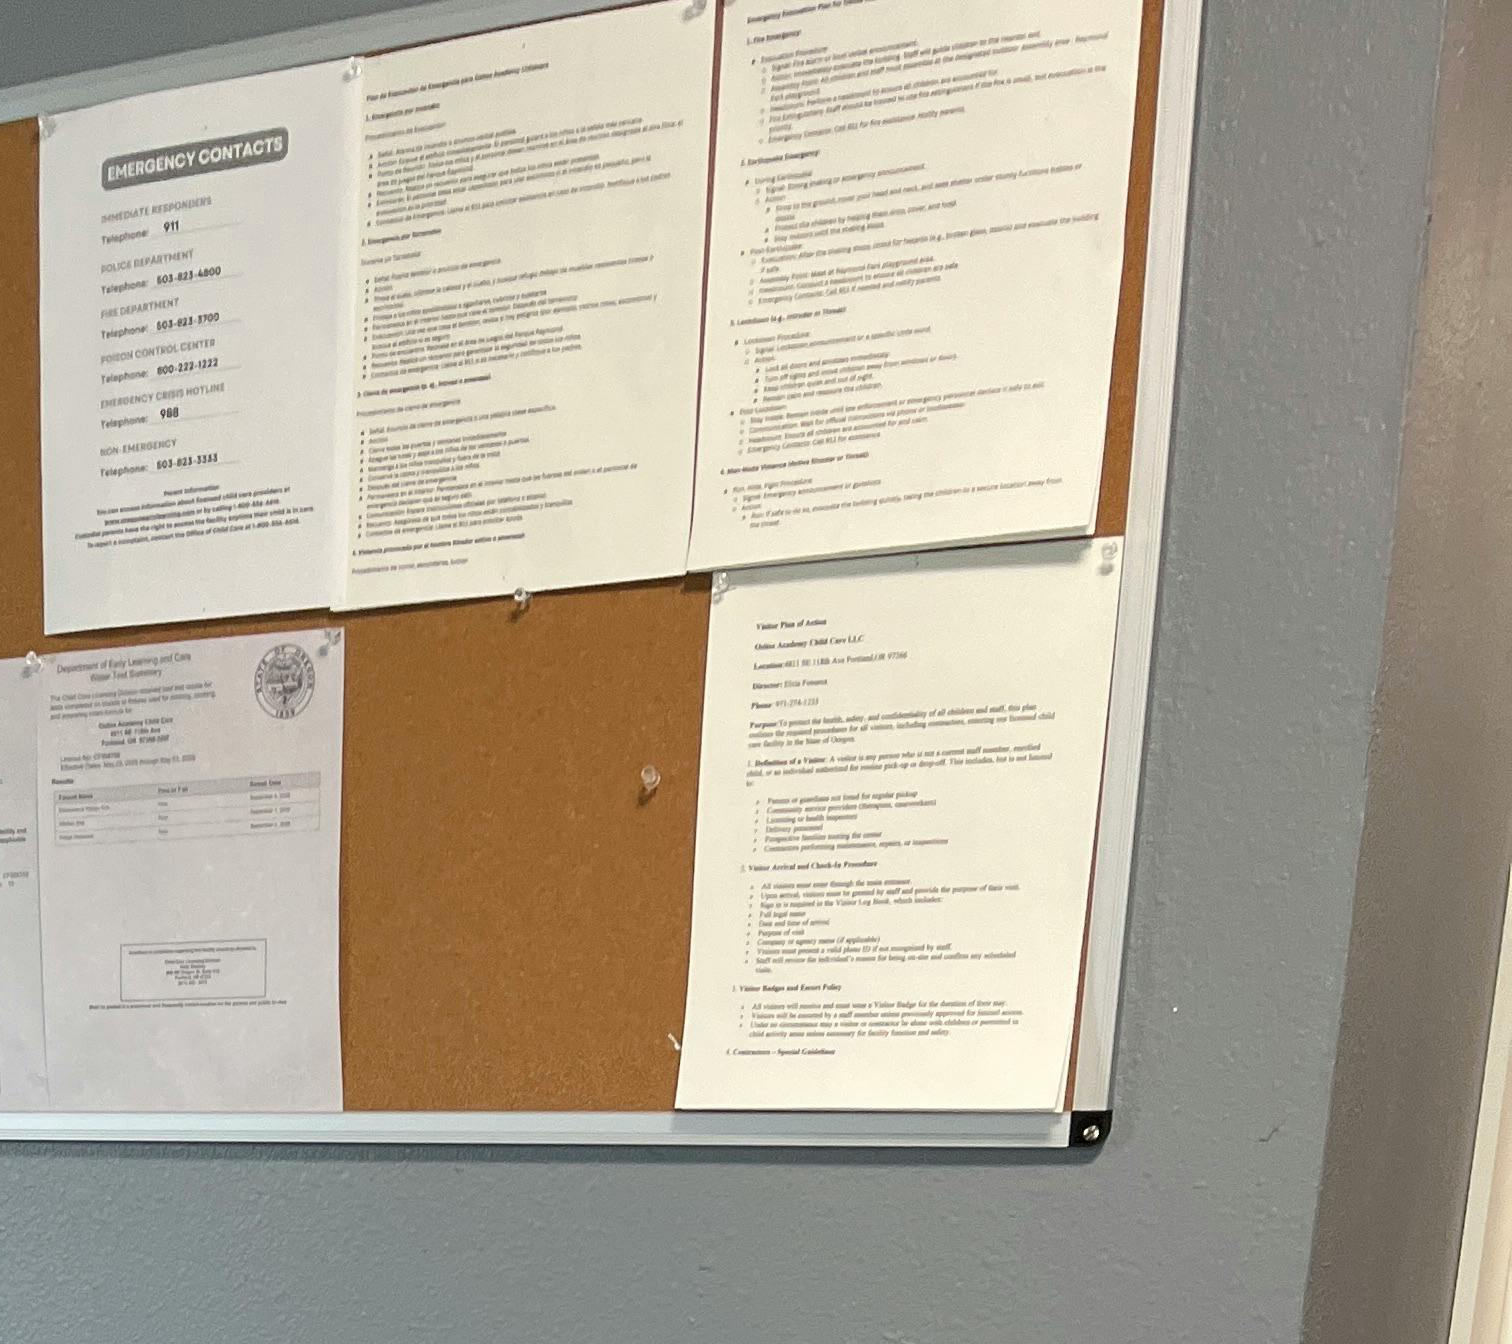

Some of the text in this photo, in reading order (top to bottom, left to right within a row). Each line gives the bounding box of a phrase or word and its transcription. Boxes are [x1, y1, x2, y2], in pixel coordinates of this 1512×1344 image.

[107, 136, 283, 182] EMERGENCY CONTACTS
[101, 196, 212, 223] IMMEDIATE RESPONDERS
[102, 220, 179, 245] Telephone: 911
[101, 249, 194, 274] POLICE DEPARTMENT
[102, 280, 149, 295] Telephone:
[101, 297, 179, 319] FIRE DEPARTMENT
[102, 325, 149, 340] Telephone:
[101, 338, 216, 364] POISON CONTROL CENTER
[101, 370, 149, 385] Telephone:
[101, 382, 225, 409] EMERGENCY CRISIS HOTLINE
[101, 407, 179, 429] Telephone: 988
[101, 465, 149, 477] Telephone:
[100, 660, 107, 670] of
[159, 653, 173, 663] and
